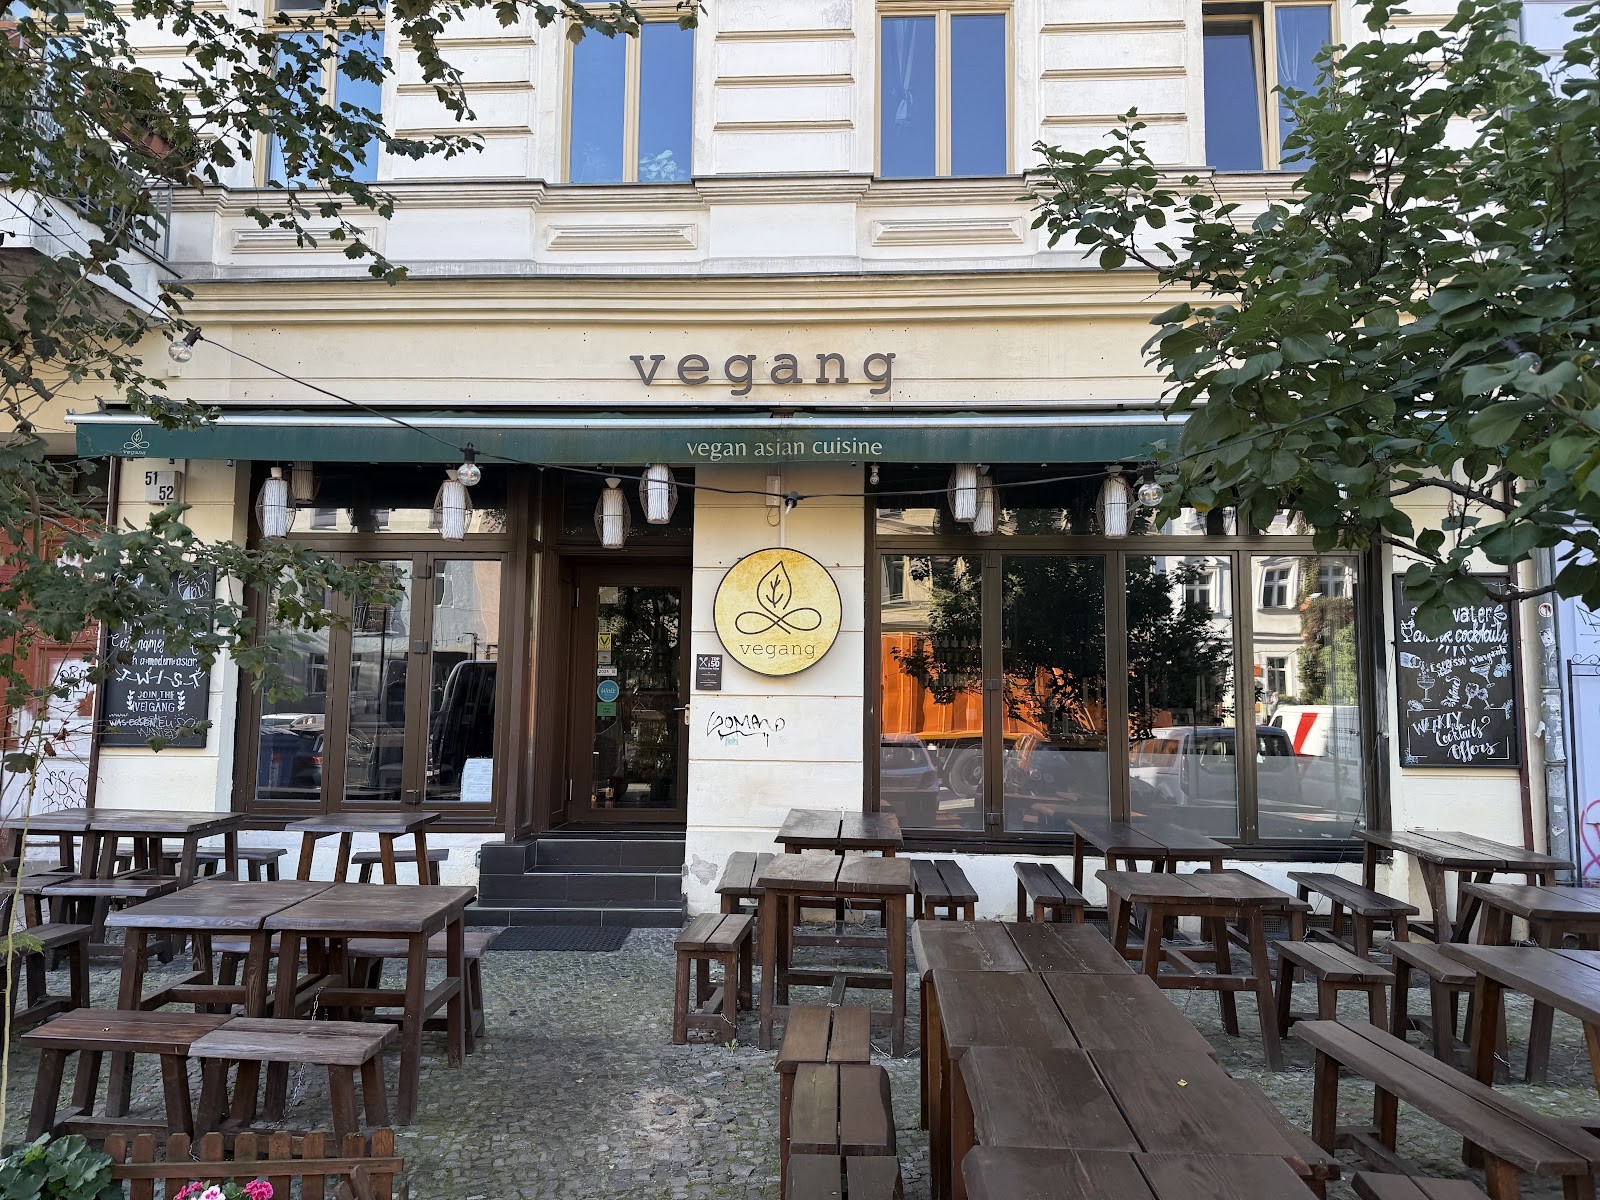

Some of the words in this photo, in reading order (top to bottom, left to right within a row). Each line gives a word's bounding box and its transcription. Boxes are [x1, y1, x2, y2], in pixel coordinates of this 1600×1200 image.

[629, 353, 896, 396] vegang
[687, 441, 747, 461] vegan
[754, 438, 805, 456] asian
[812, 437, 883, 456] cuisine
[145, 471, 158, 485] 51
[159, 486, 174, 500] 52
[1456, 621, 1508, 644] cocktails
[739, 643, 816, 659] vegang
[116, 668, 202, 688] TWIST
[137, 690, 158, 699] JOIN
[159, 690, 175, 699] THE
[1435, 716, 1491, 746] Cocktails
[1447, 739, 1501, 763] Offers
